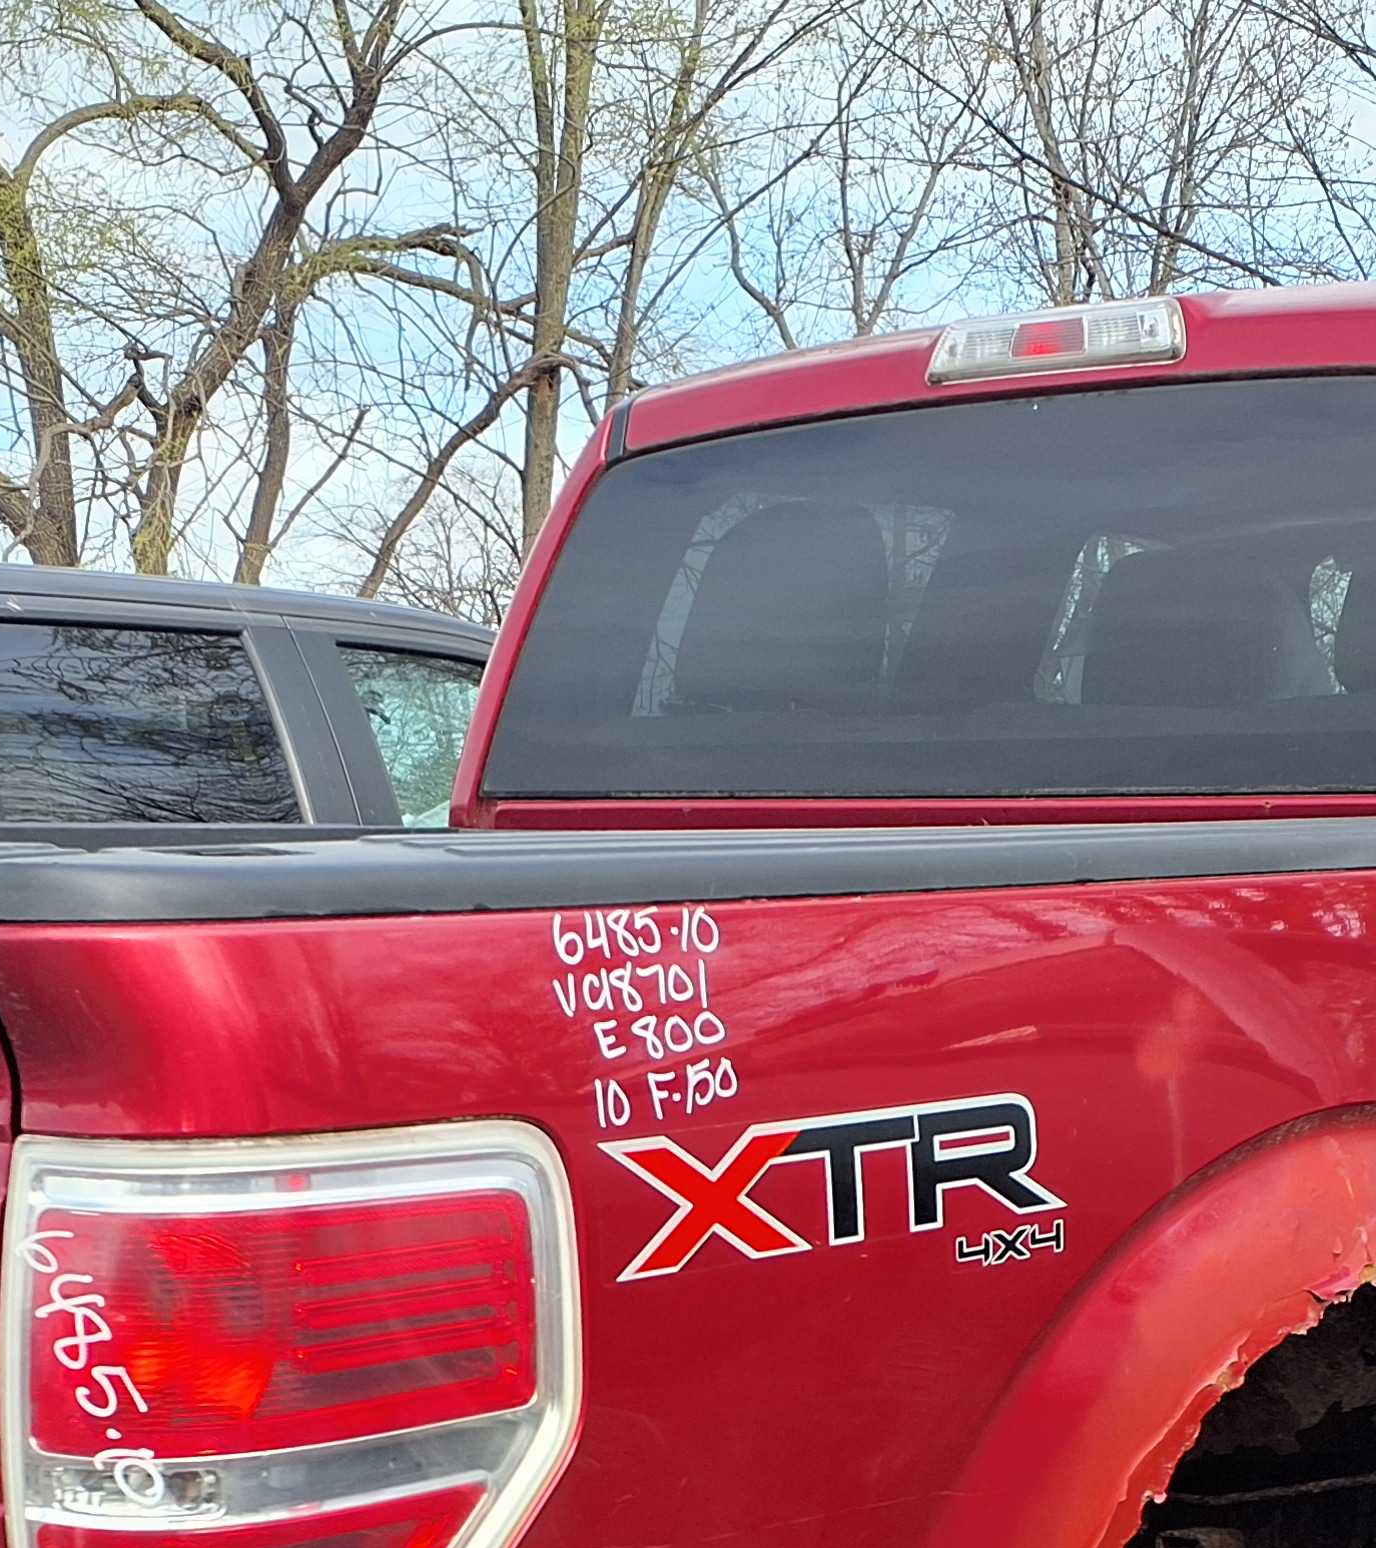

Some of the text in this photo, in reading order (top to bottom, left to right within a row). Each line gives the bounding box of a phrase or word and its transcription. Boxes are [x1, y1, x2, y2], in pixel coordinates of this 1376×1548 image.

[593, 1011, 726, 1060] E 800
[594, 1079, 631, 1128] 10
[597, 1093, 1068, 1282] XTR
